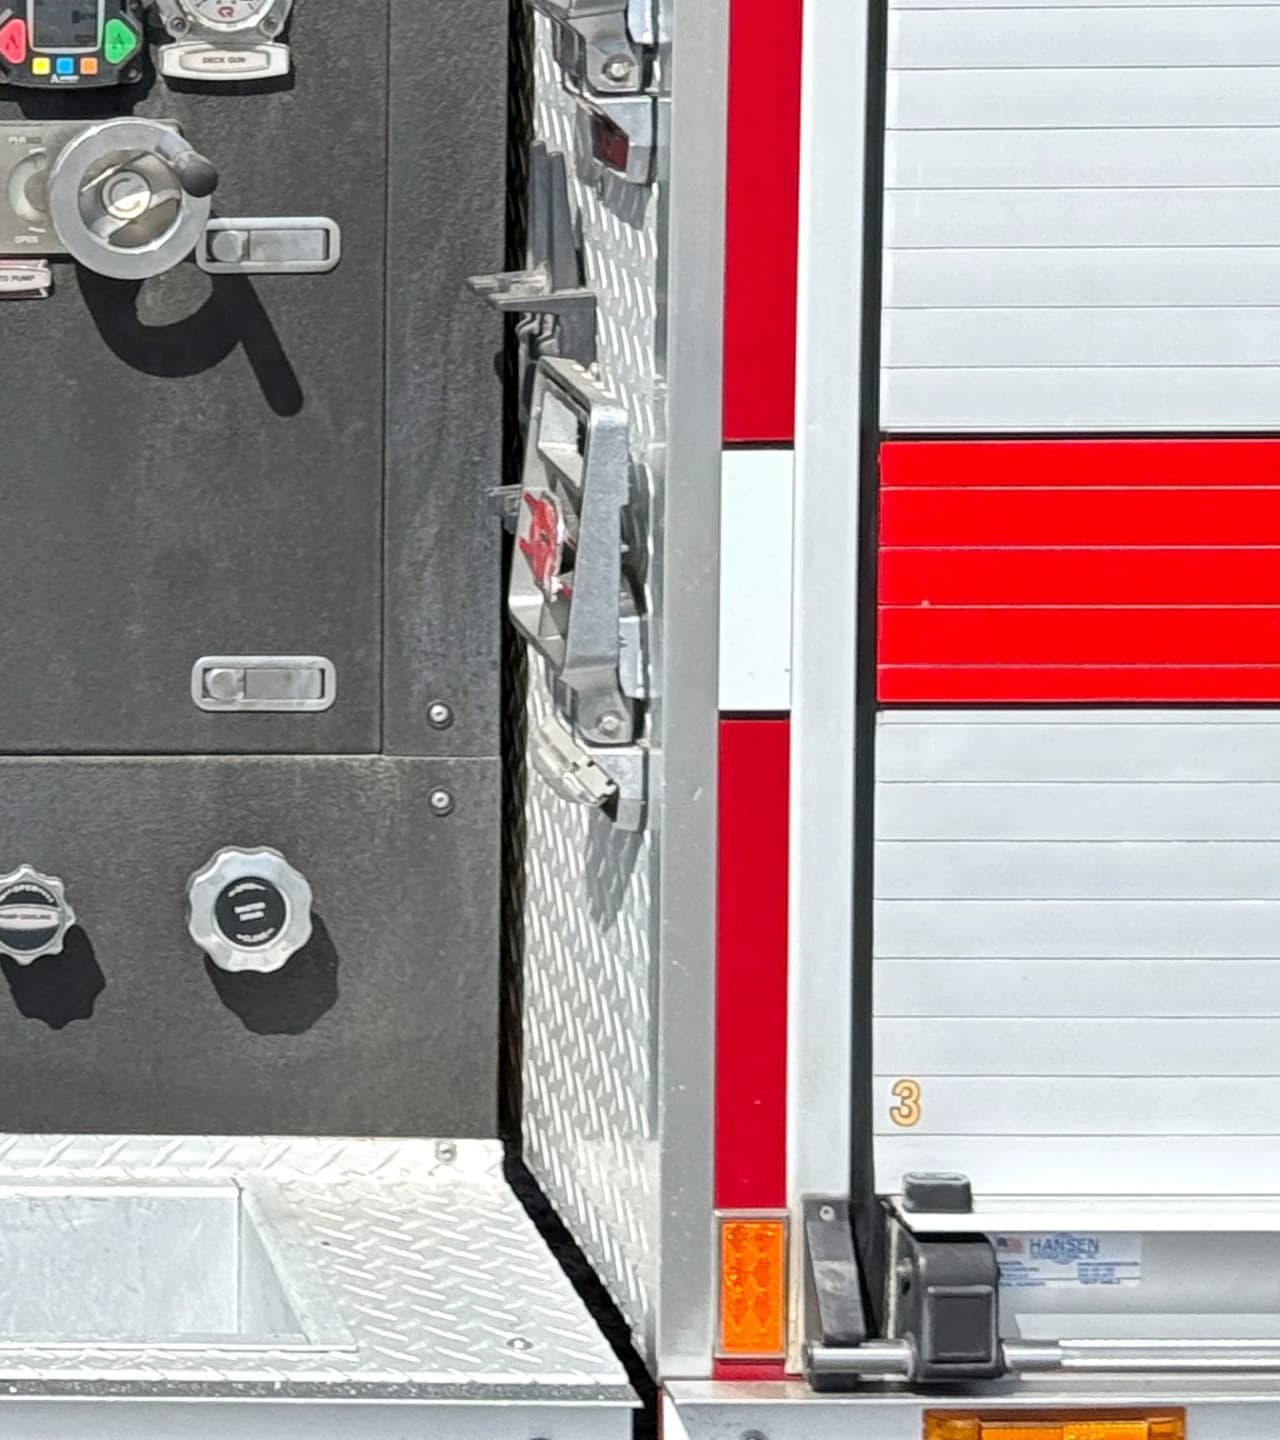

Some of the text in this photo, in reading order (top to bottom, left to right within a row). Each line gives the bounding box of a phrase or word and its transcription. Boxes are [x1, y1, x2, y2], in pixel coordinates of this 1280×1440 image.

[202, 56, 226, 65] DECK
[888, 1078, 923, 1128] 3
[1030, 1238, 1100, 1253] HANSEN
